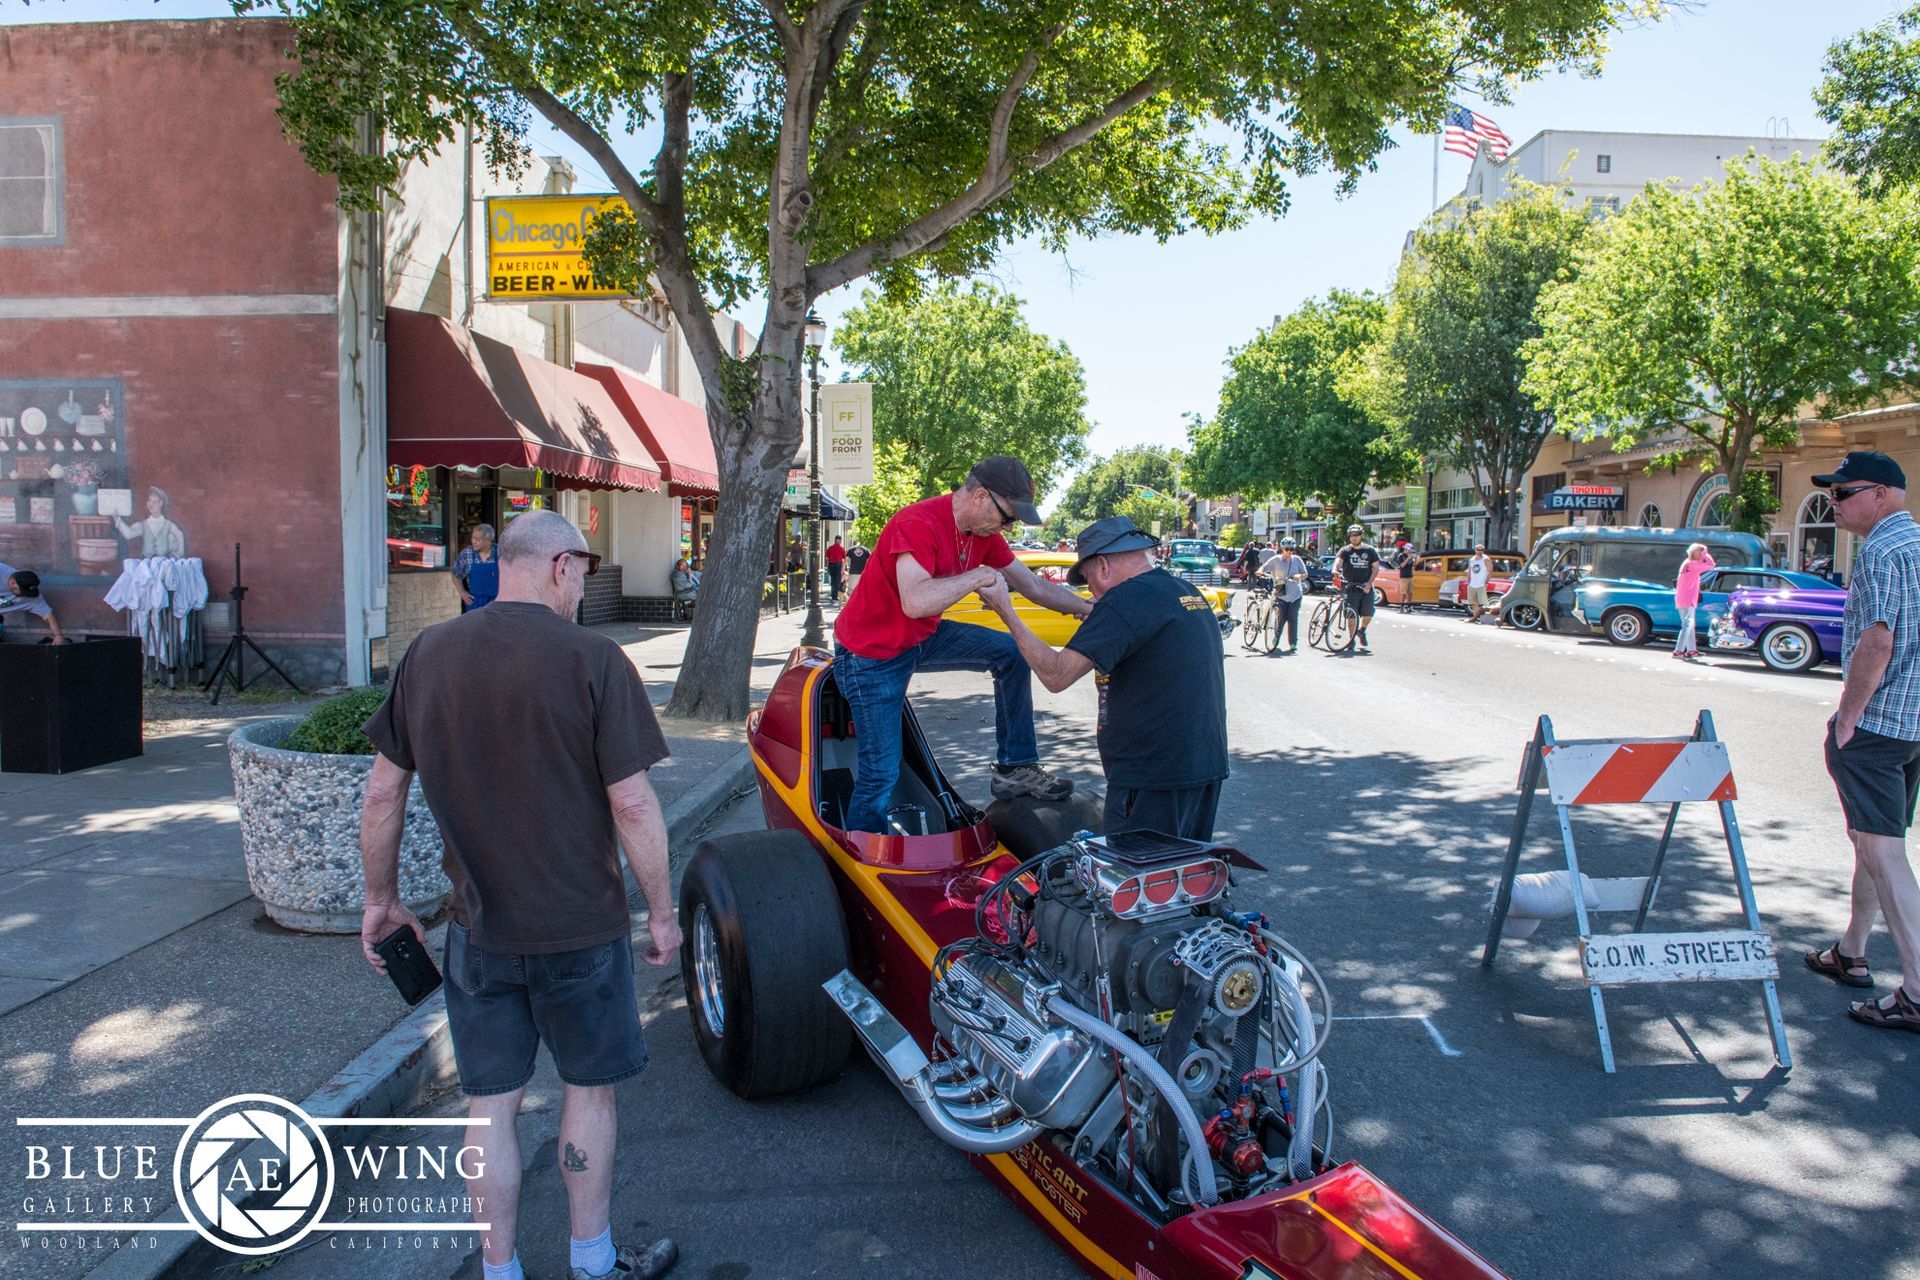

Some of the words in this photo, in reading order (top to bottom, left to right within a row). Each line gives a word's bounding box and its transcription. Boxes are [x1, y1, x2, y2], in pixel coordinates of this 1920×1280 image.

[492, 209, 577, 249] Chicago
[497, 261, 559, 272] AMERICAN
[839, 411, 855, 422] FF
[832, 437, 862, 446] FOOD
[832, 446, 862, 454] FRONT
[1571, 486, 1614, 495] TIMOTHY'S
[1552, 496, 1620, 509] BAKERY
[1664, 939, 1767, 965] STREETS
[1053, 1166, 1089, 1201] ART
[1034, 1169, 1081, 1224] FOSTER
